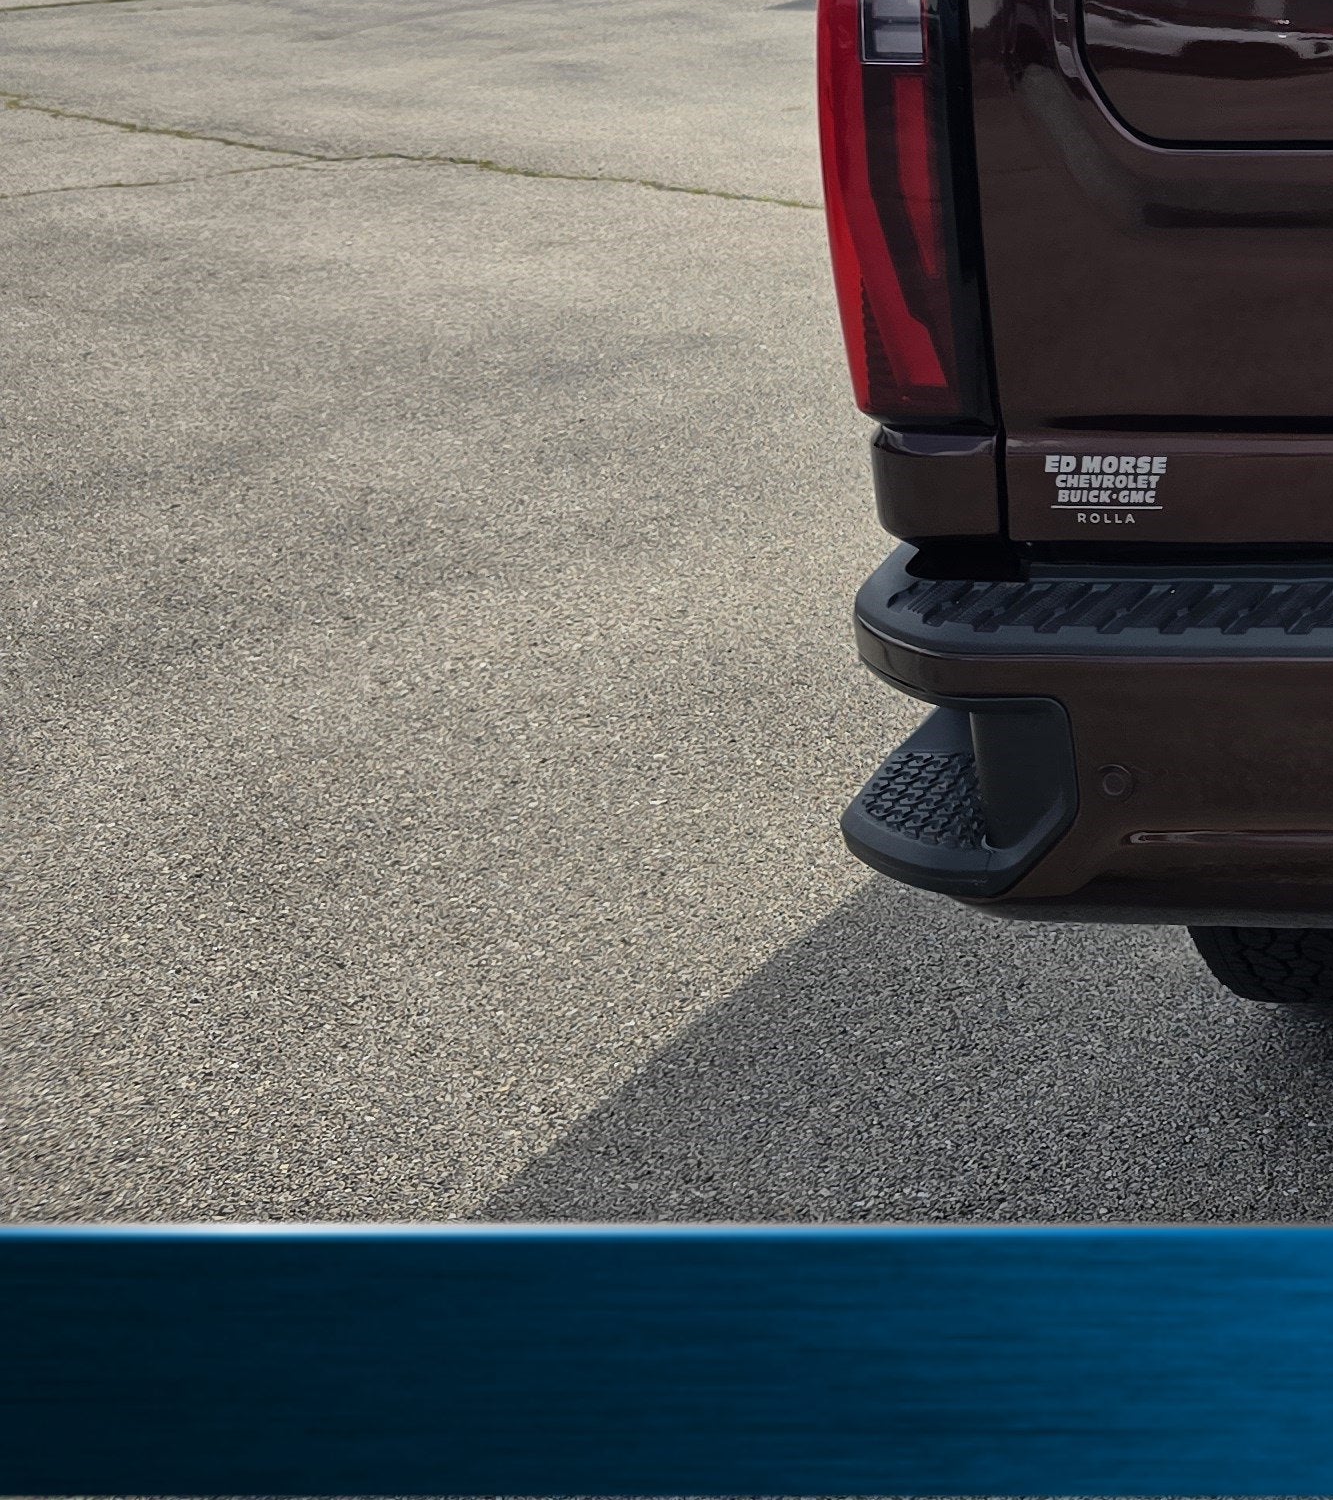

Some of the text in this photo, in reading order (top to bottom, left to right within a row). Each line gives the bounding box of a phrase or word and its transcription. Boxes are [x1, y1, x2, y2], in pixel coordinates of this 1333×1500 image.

[1044, 455, 1168, 474] ED MORSE
[1055, 474, 1160, 489] CHEVROLET
[1077, 512, 1136, 525] ROLLA
